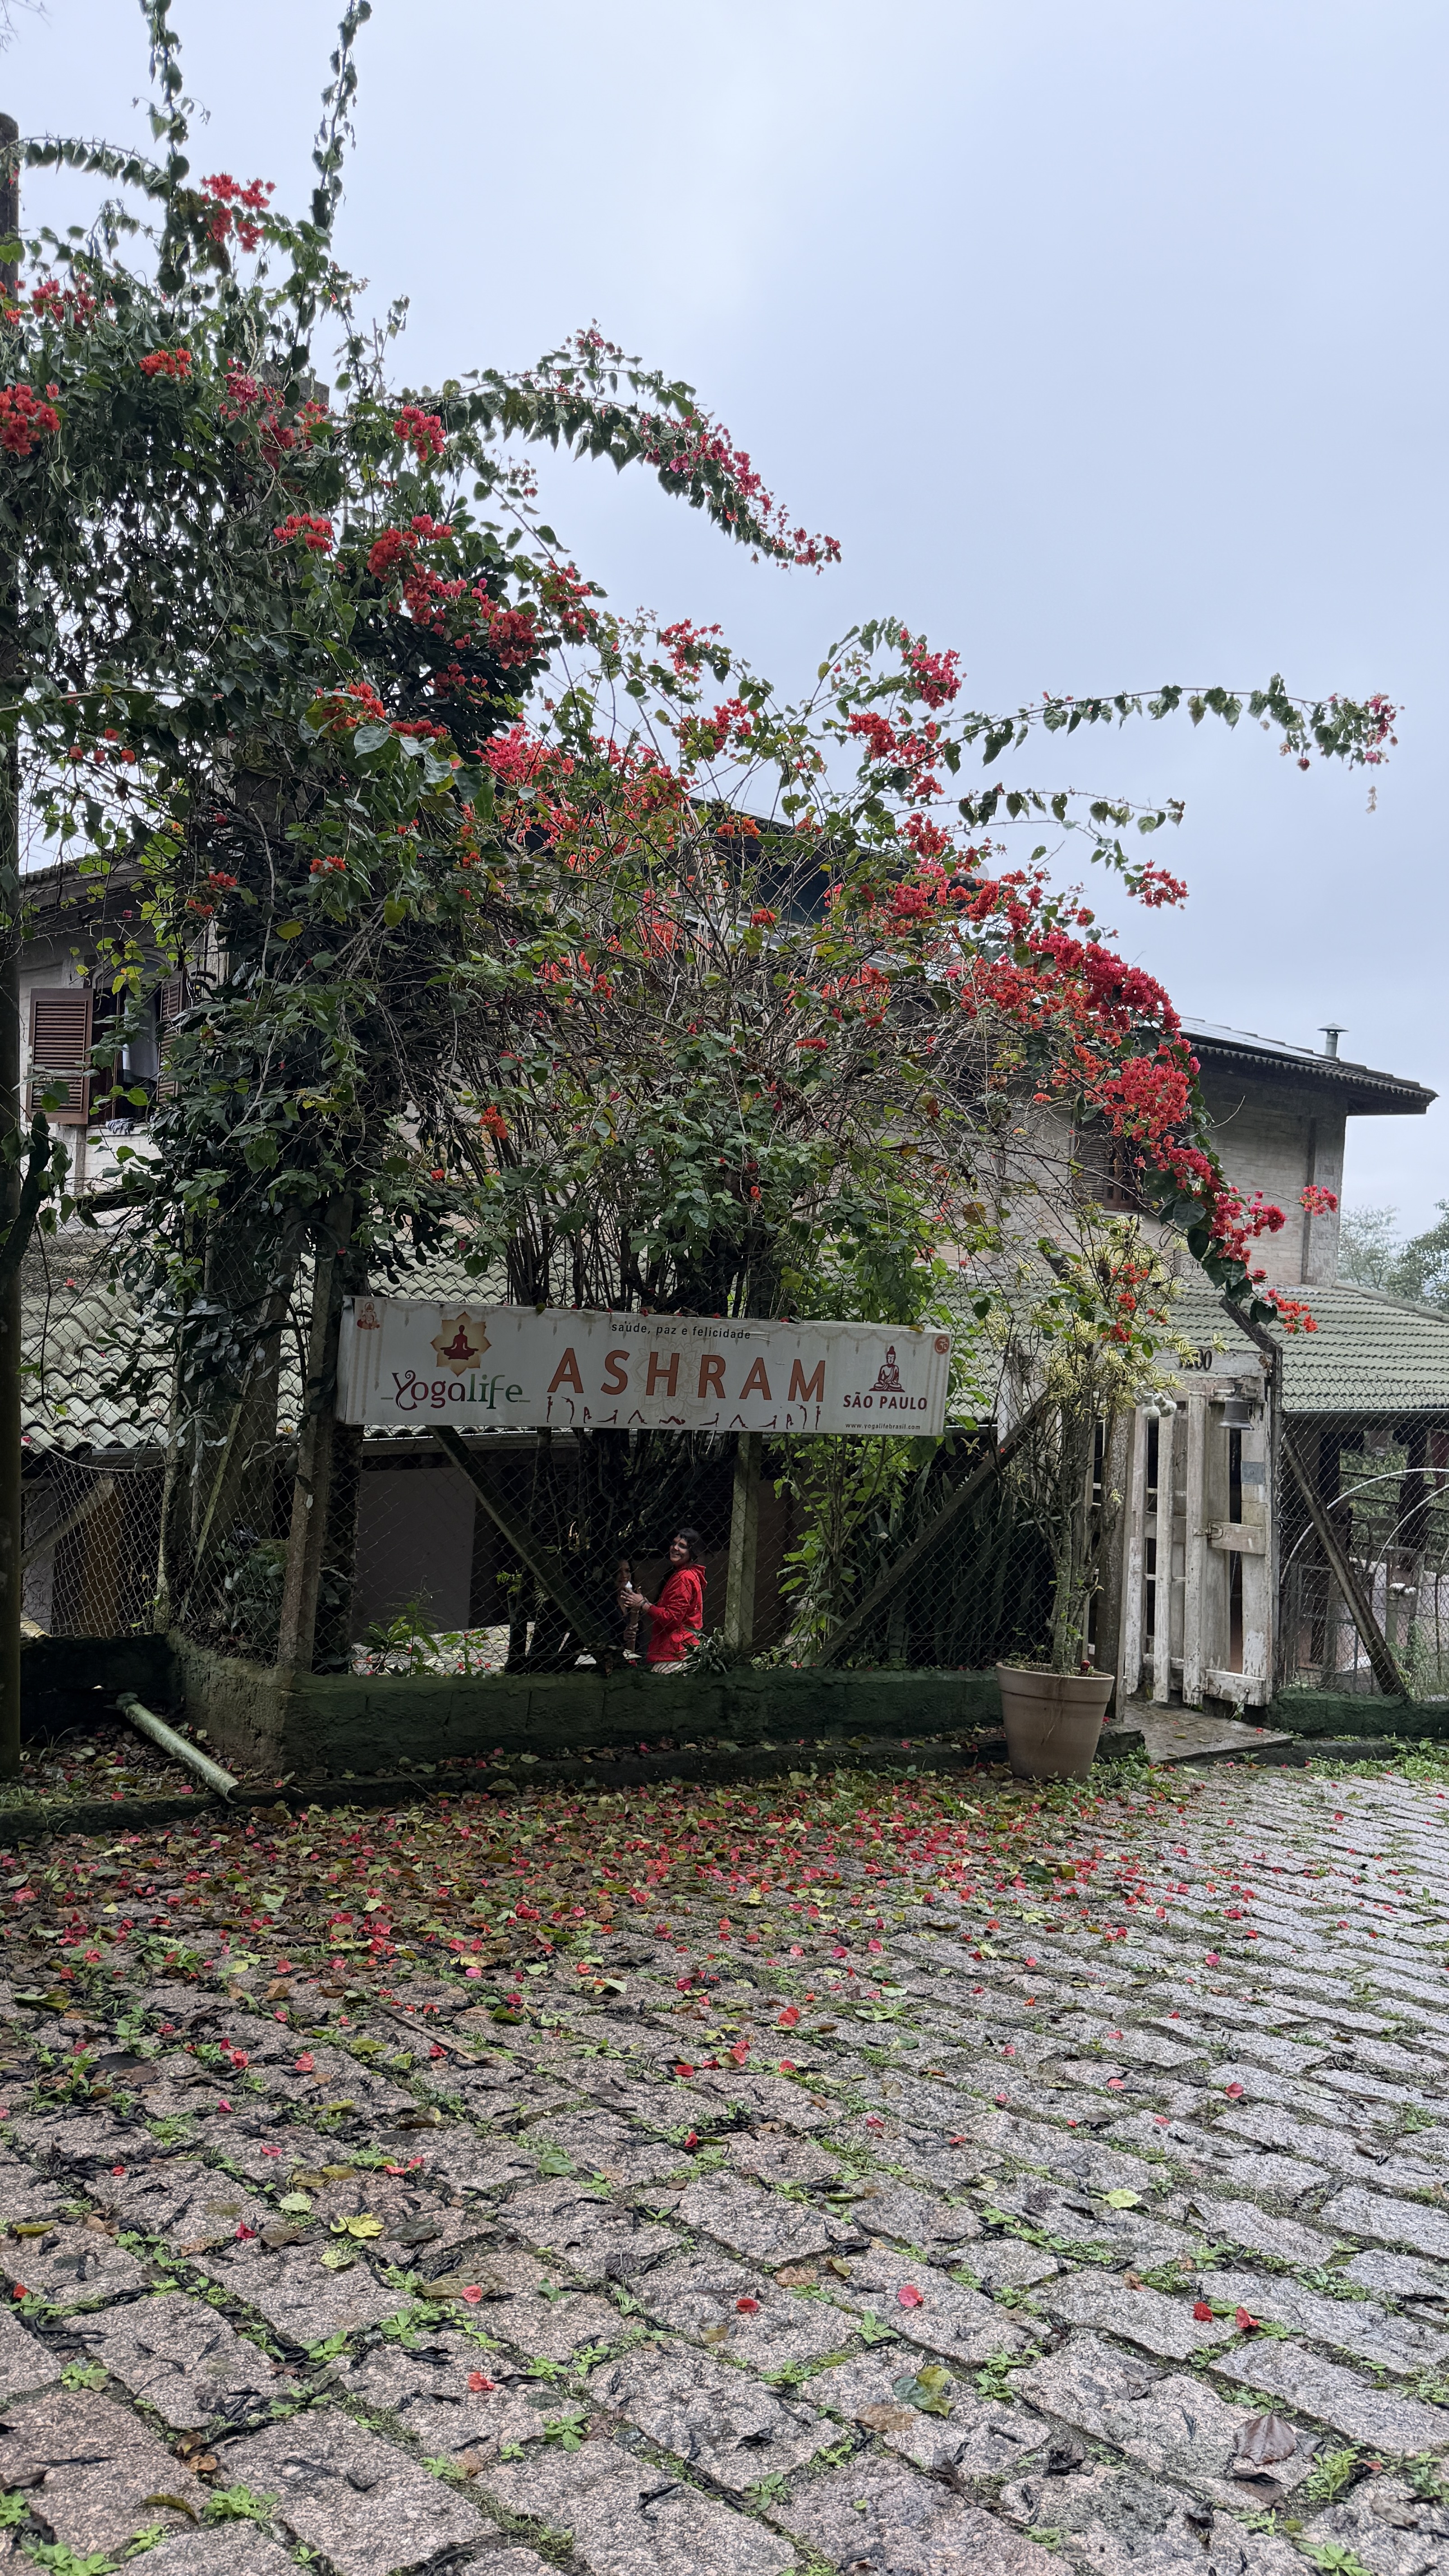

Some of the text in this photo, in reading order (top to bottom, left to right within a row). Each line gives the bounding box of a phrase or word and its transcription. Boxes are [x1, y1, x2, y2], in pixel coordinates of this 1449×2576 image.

[612, 1322, 750, 1339] saúde, paz e felicidade
[547, 1348, 825, 1402] ASHRAM
[392, 1370, 523, 1411] Yogalife
[843, 1392, 927, 1410] SÃO PAULO
